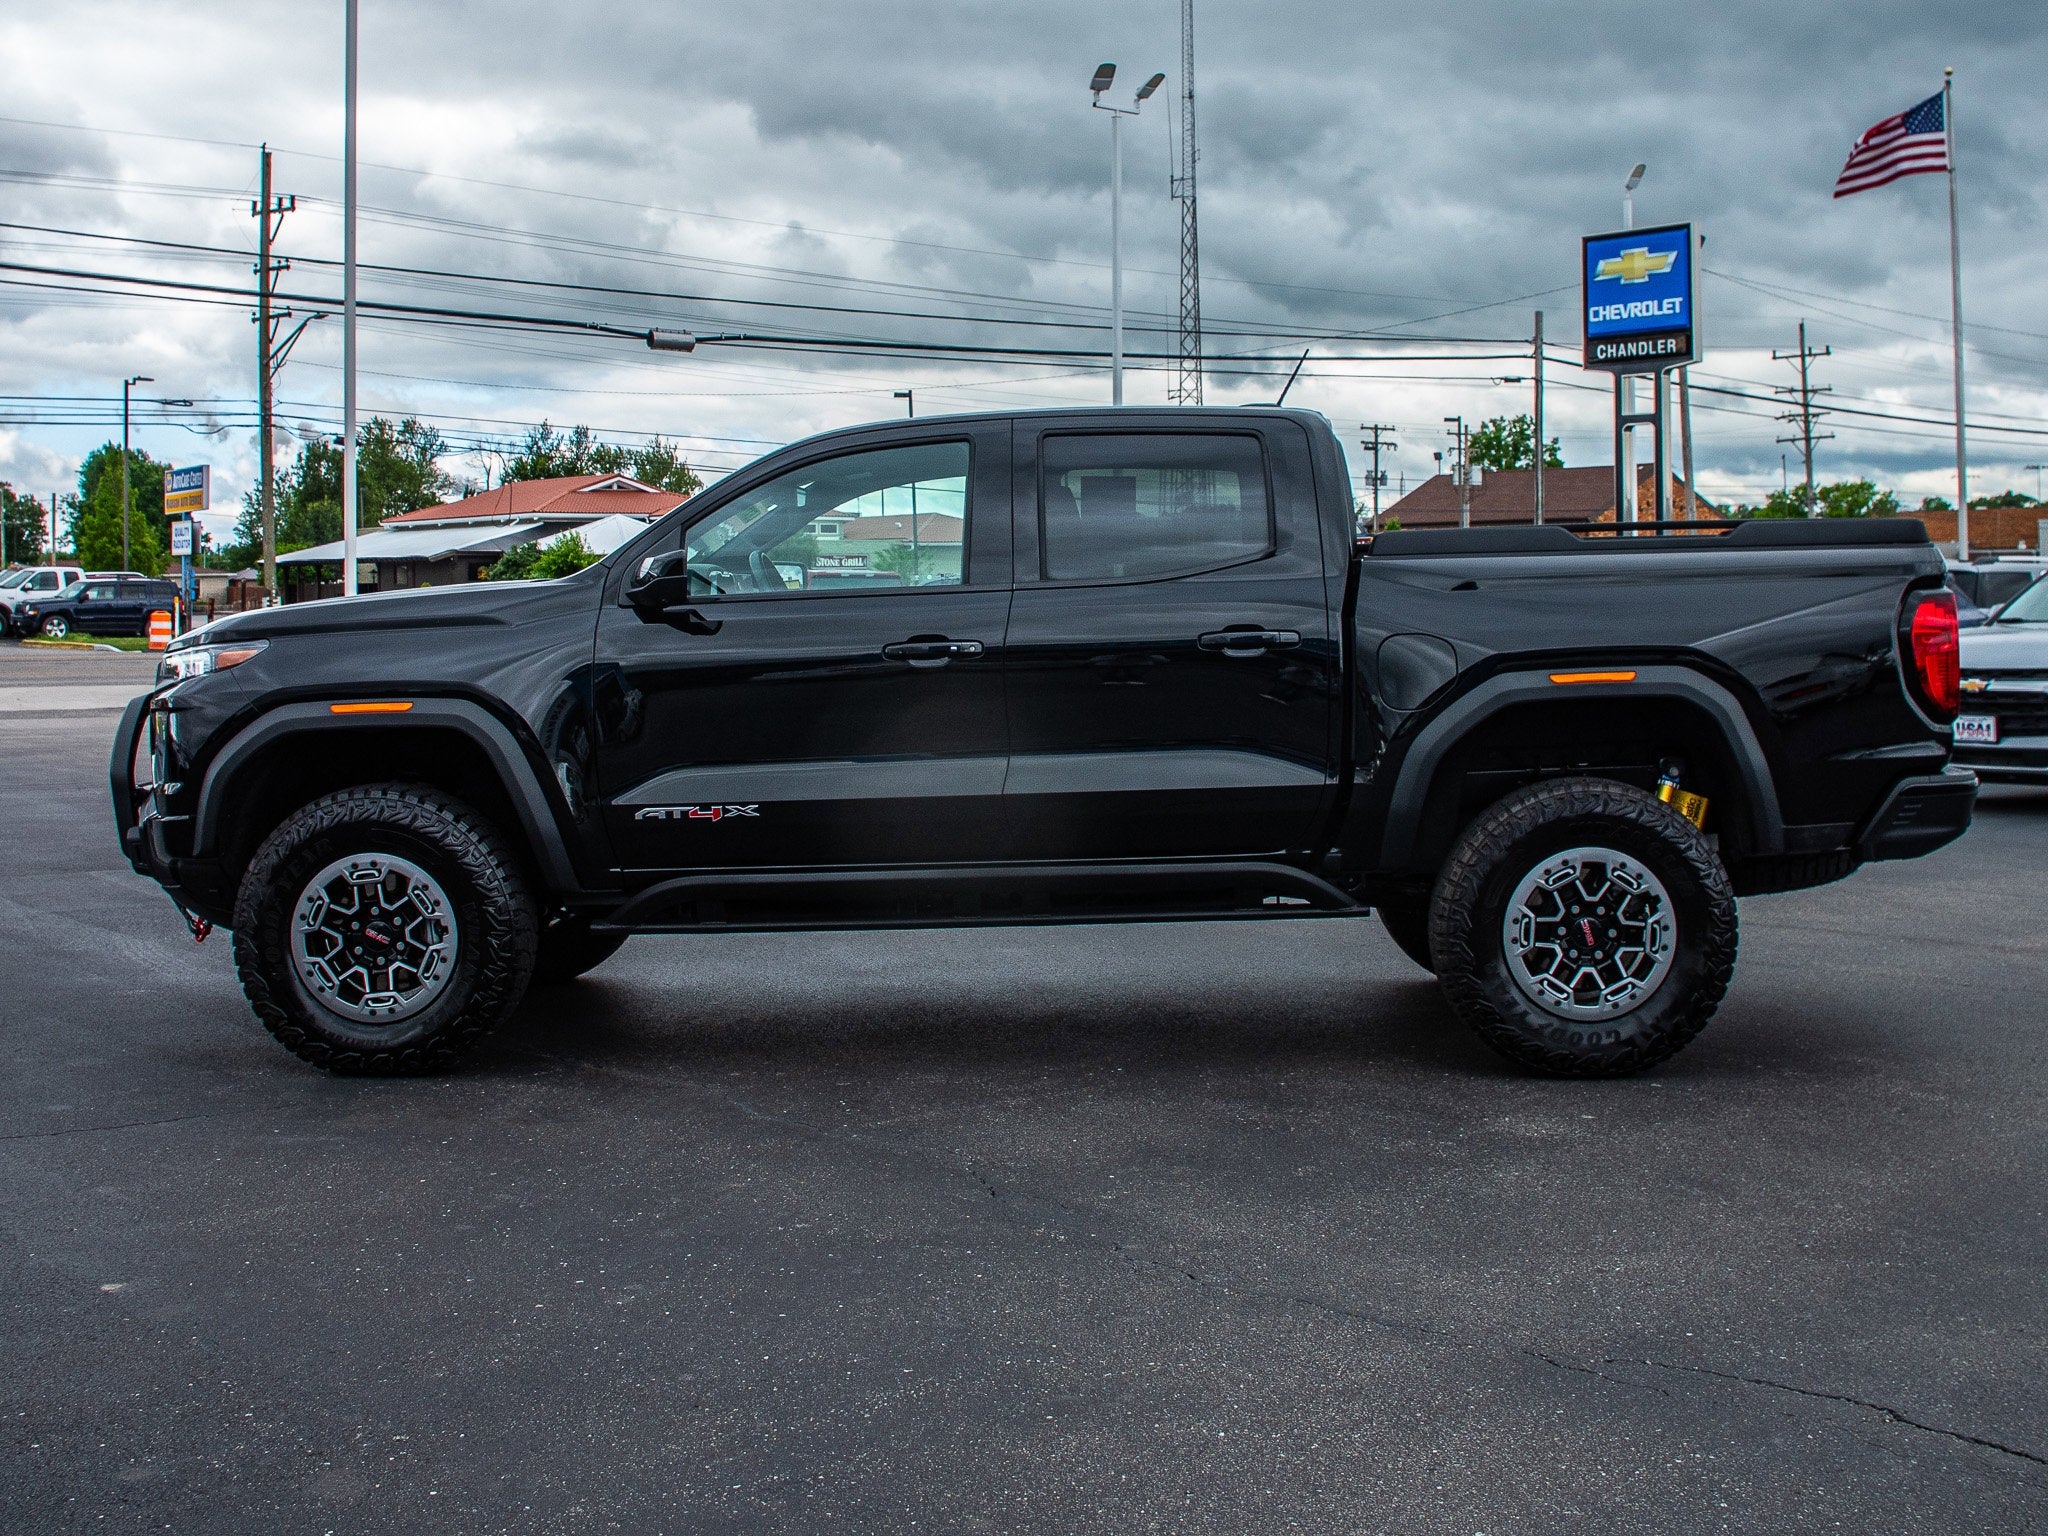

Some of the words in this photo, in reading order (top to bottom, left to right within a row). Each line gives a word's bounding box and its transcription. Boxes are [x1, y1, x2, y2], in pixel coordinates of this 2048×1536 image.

[1588, 297, 1683, 323] CHEVROLET
[1596, 339, 1677, 360] CHANDLER
[175, 527, 189, 537] QUALITY
[815, 556, 840, 567] STONE
[841, 557, 864, 567] GRILL
[634, 804, 760, 822] AT4X
[365, 928, 391, 945] GMC
[1580, 919, 1595, 946] GMC
